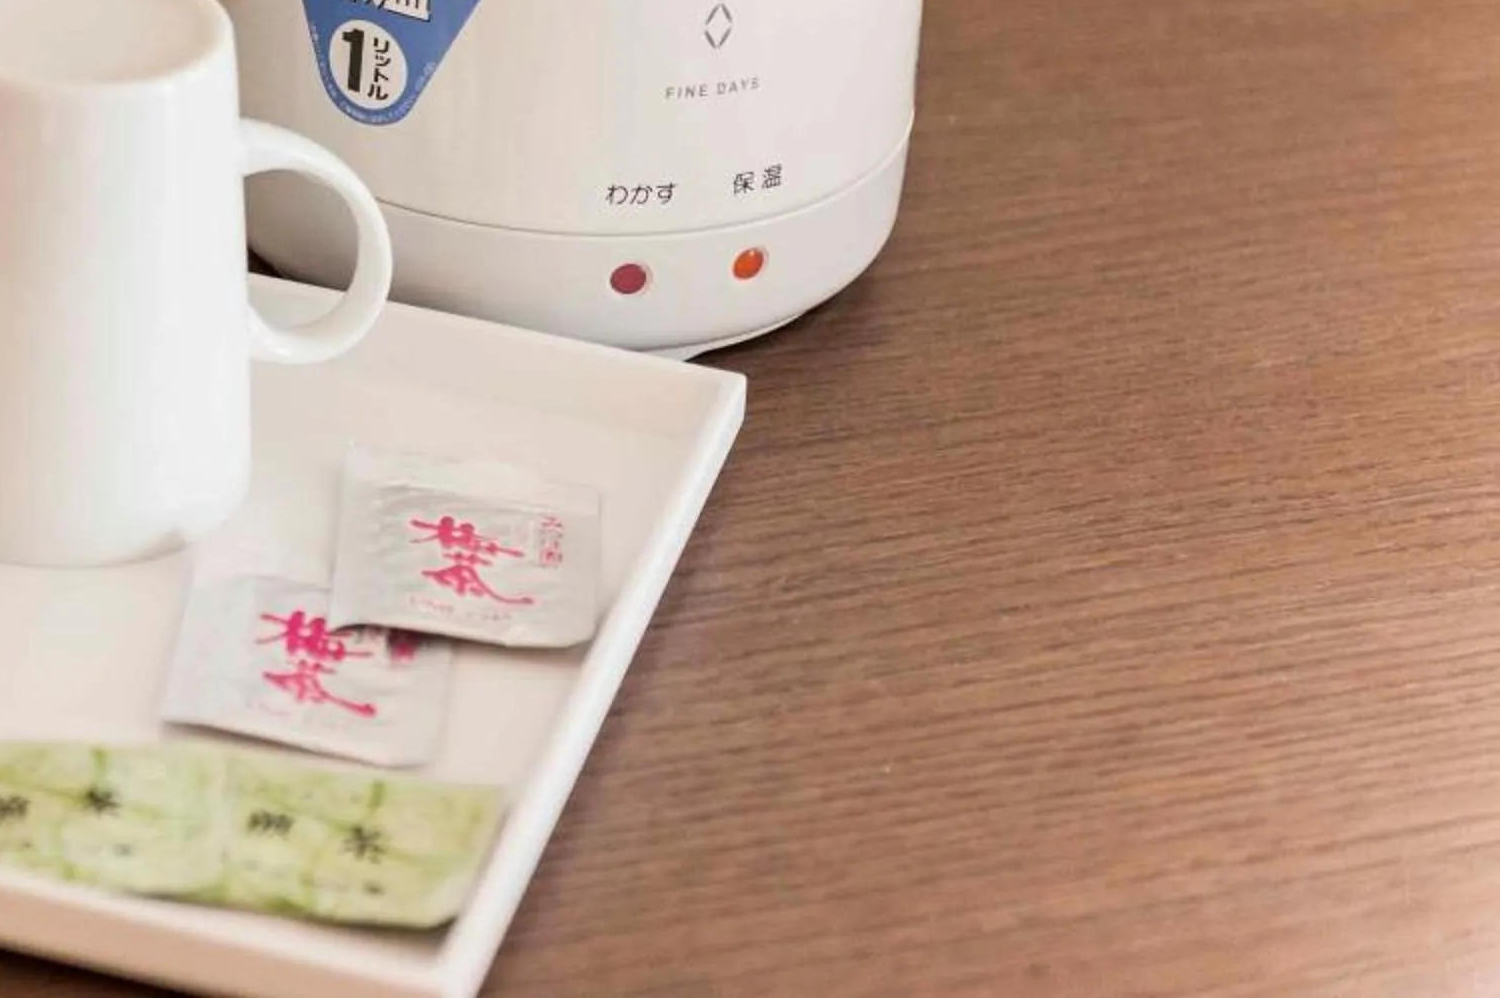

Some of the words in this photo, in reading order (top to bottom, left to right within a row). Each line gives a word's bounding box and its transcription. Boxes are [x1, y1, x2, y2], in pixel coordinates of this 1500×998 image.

[342, 28, 364, 93] 1
[367, 37, 391, 101] リットル
[665, 84, 708, 100] FINE
[717, 76, 760, 95] DAYS
[605, 182, 676, 205] わかす
[733, 164, 782, 195] 保温
